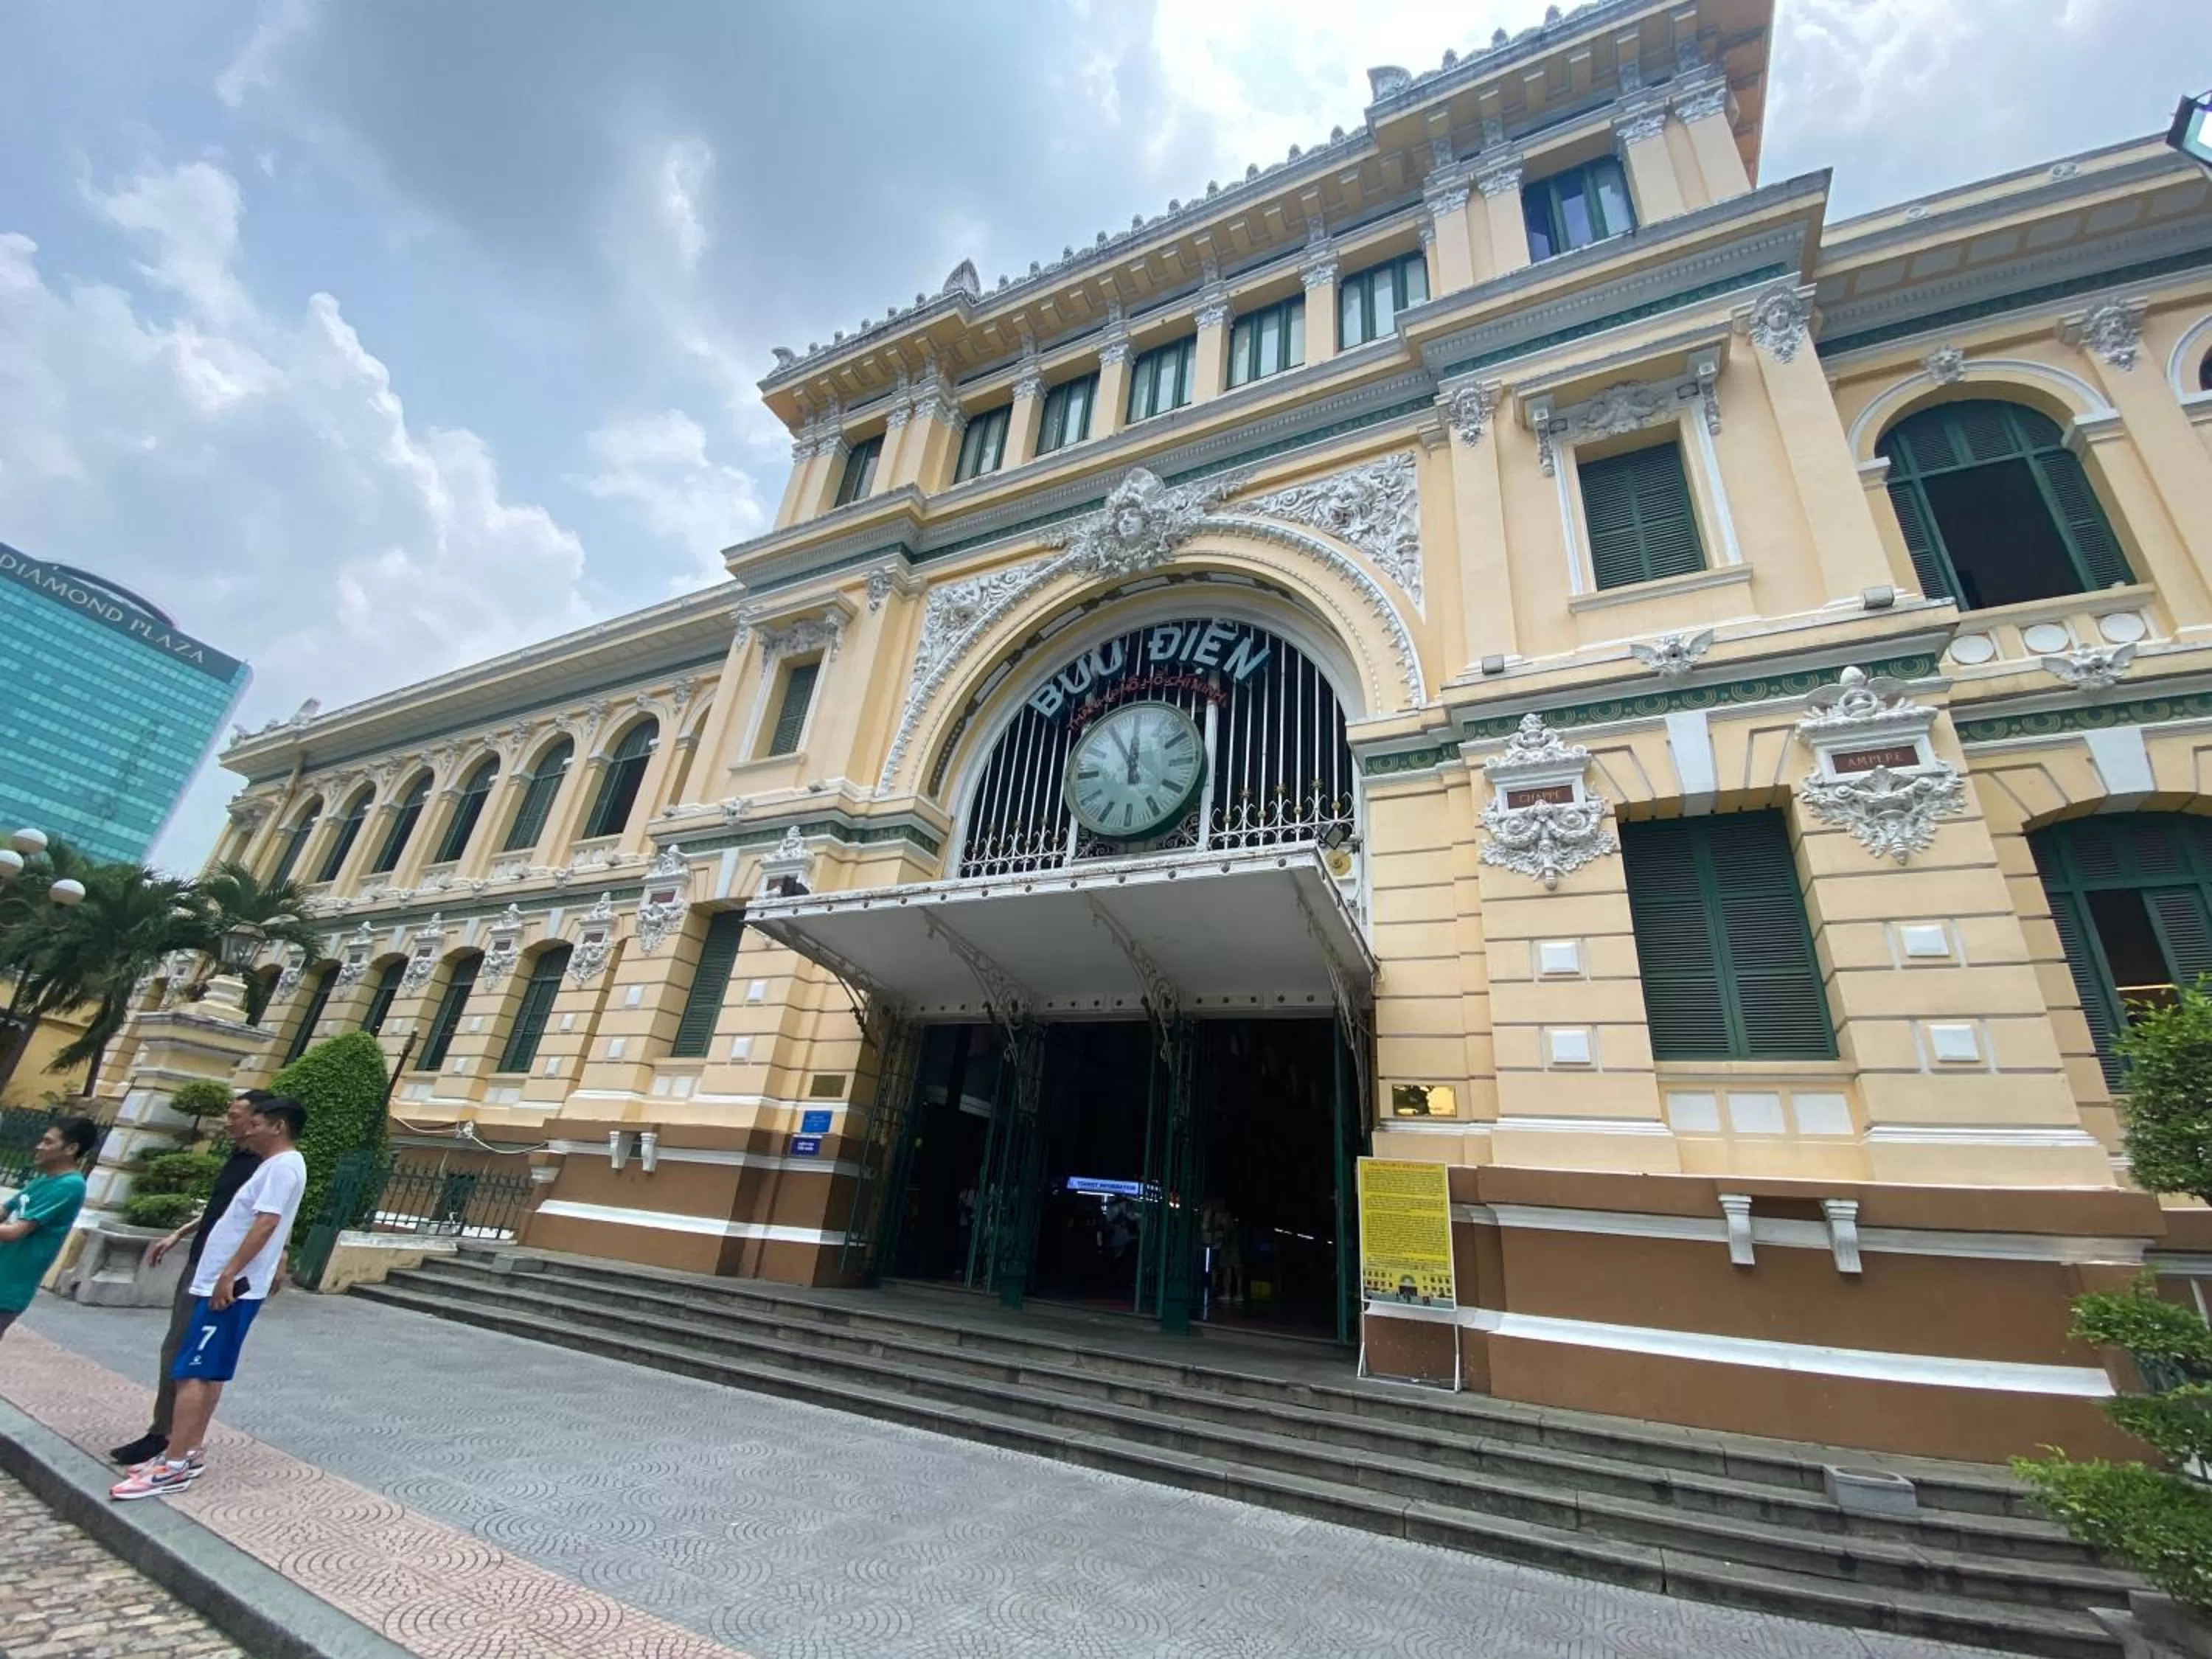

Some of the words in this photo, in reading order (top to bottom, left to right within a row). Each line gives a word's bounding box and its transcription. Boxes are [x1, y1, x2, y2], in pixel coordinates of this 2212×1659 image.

[0, 554, 124, 622] DIAMOND
[129, 618, 206, 664] PLAZA
[197, 1324, 218, 1351] 7
